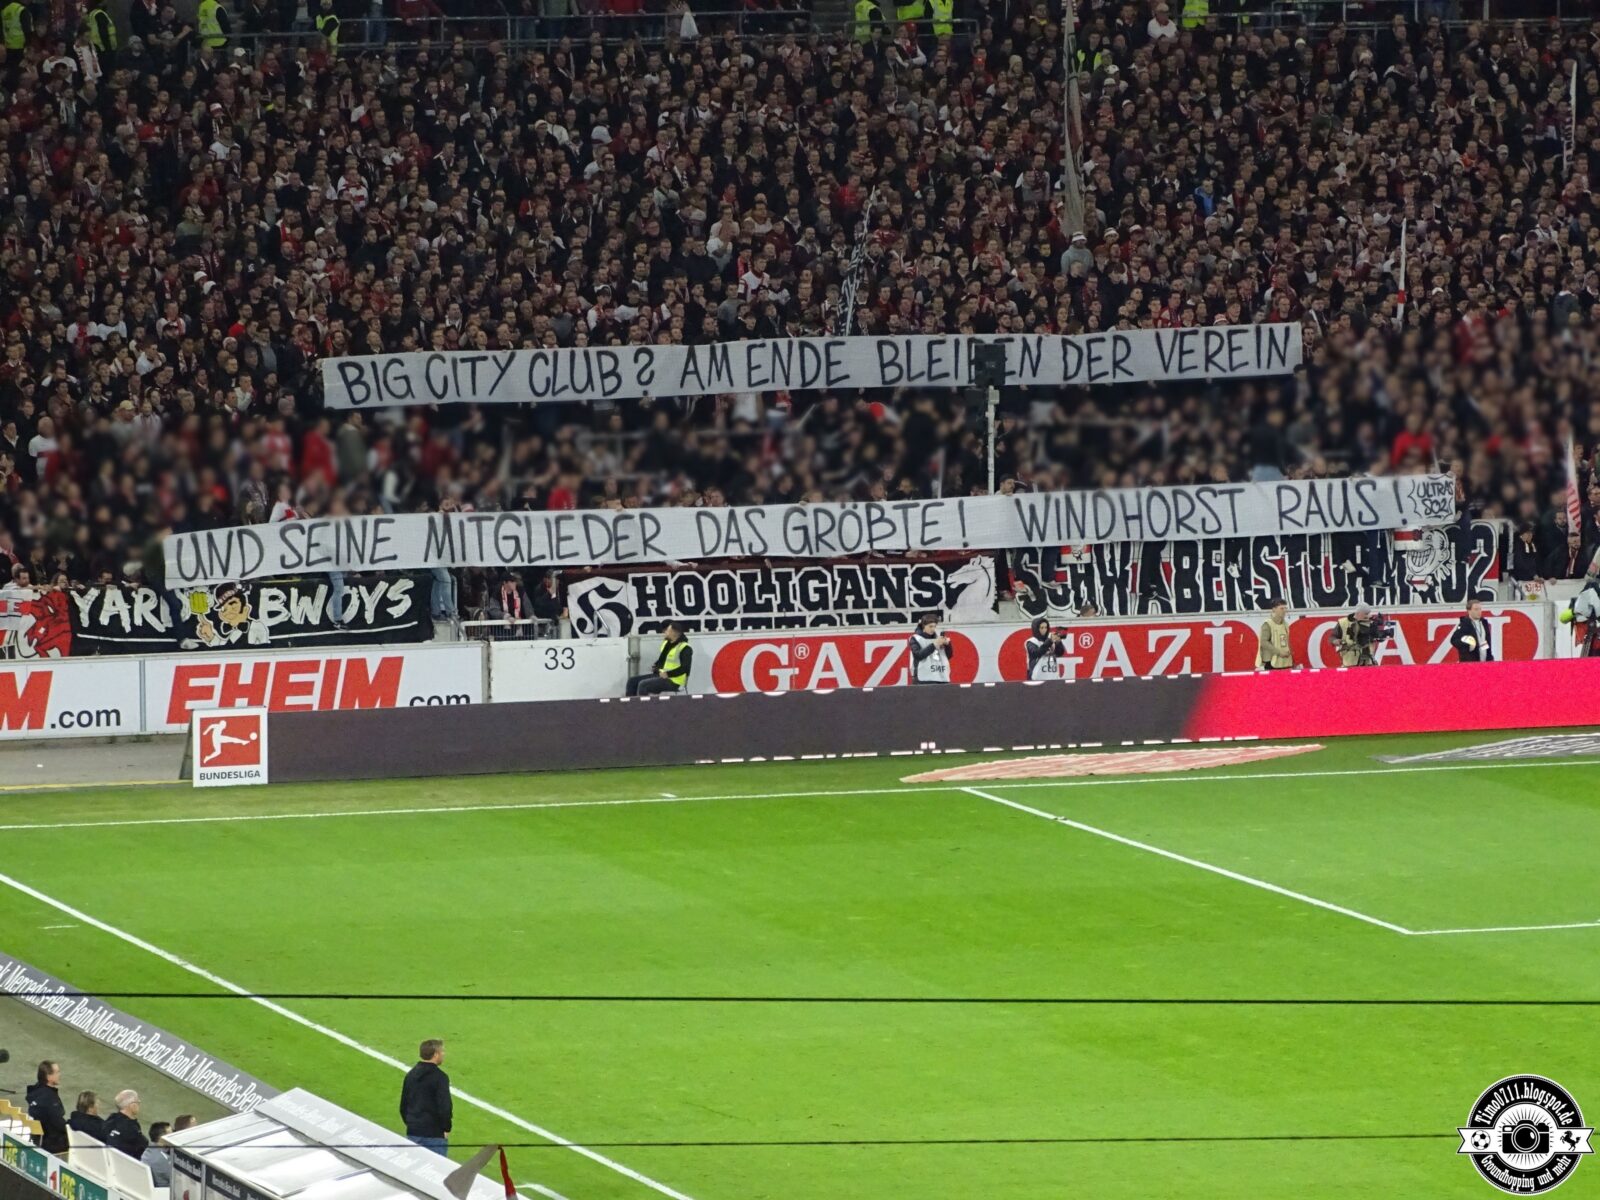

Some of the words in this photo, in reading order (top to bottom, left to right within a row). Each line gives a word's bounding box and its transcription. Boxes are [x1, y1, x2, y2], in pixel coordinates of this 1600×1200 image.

[337, 358, 415, 405] BIG
[425, 351, 516, 400] CITY
[680, 344, 734, 390] AM
[747, 339, 850, 388] ENDE
[1062, 334, 1134, 382] DER
[1155, 325, 1290, 373] VEREIN
[1416, 480, 1454, 499] ULTRAS
[176, 527, 264, 581] UND
[280, 517, 397, 569] SEINE
[424, 513, 666, 563] MITGLIEDER
[696, 508, 769, 556] DAS
[1015, 487, 1245, 542] WINDHORST
[629, 564, 947, 618] HOOLIGANS
[544, 647, 576, 670] 33
[741, 638, 909, 692] GAZ
[166, 656, 404, 724] EHEIM
[199, 769, 261, 781] BUNDESLIGA
[1, 964, 75, 1018] Mercedes-Benz
[71, 997, 102, 1033] Bank
[88, 1012, 173, 1072] Mercedes-Benz
[161, 1044, 196, 1084] Bank
